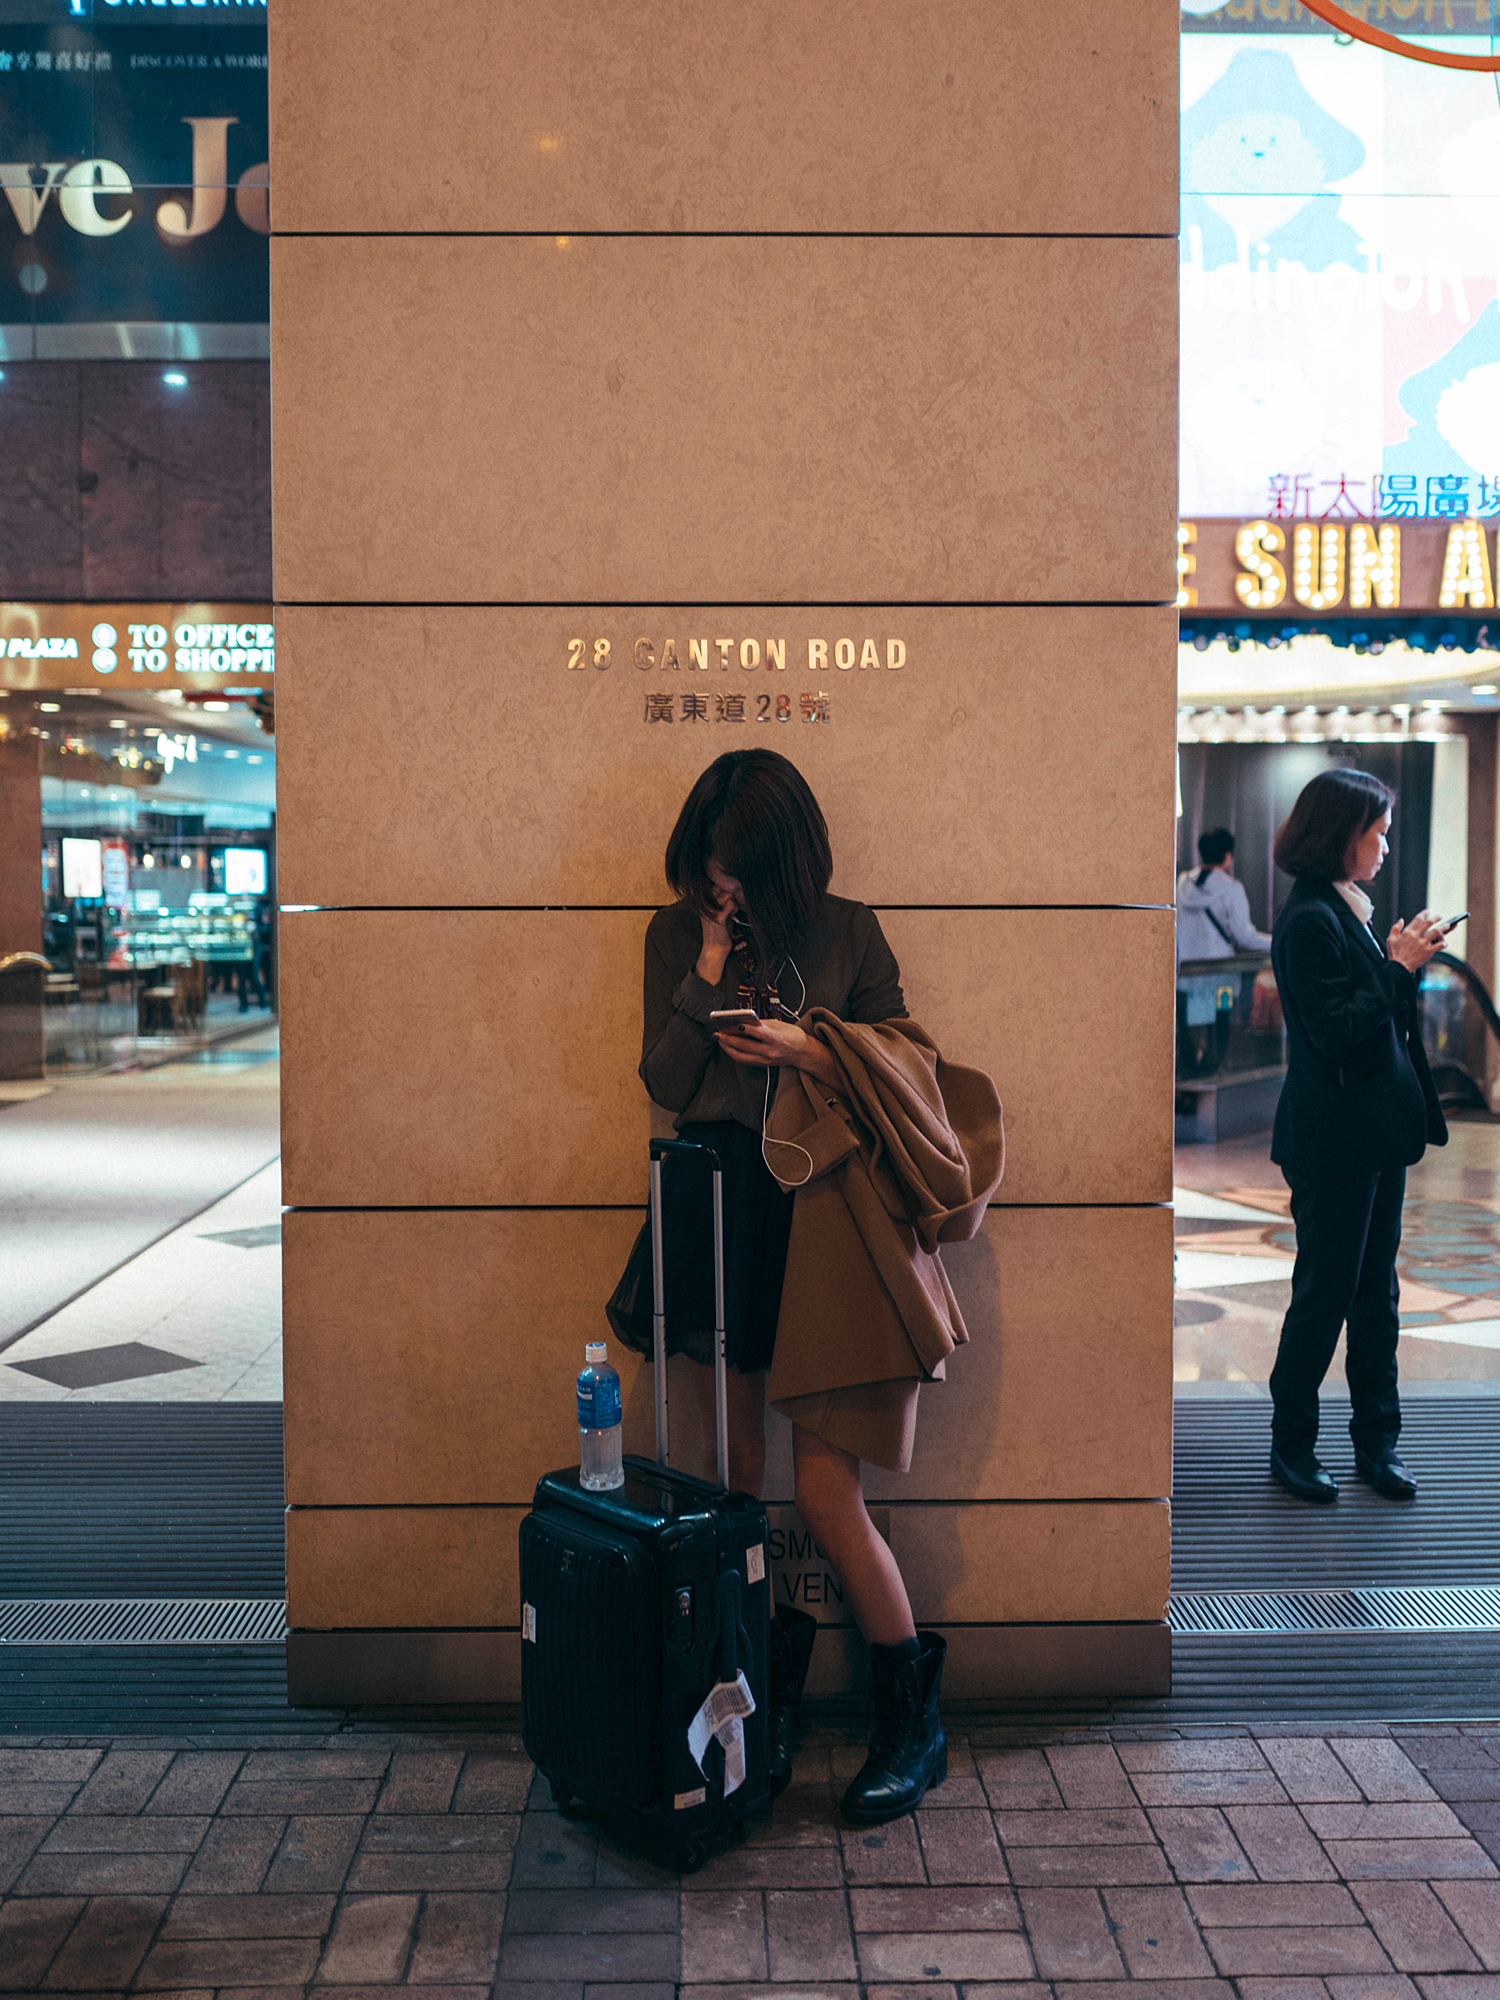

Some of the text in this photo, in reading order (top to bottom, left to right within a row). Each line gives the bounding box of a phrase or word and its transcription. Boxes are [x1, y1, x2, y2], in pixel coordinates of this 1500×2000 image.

[1235, 520, 1401, 610] SUN
[1438, 518, 1500, 609] A
[7, 637, 79, 659] PLAZA
[127, 623, 275, 648] TO OFFICE
[127, 648, 168, 673] TO
[567, 637, 907, 671] 28 CANTON ROAD
[769, 1529, 828, 1561] SM
